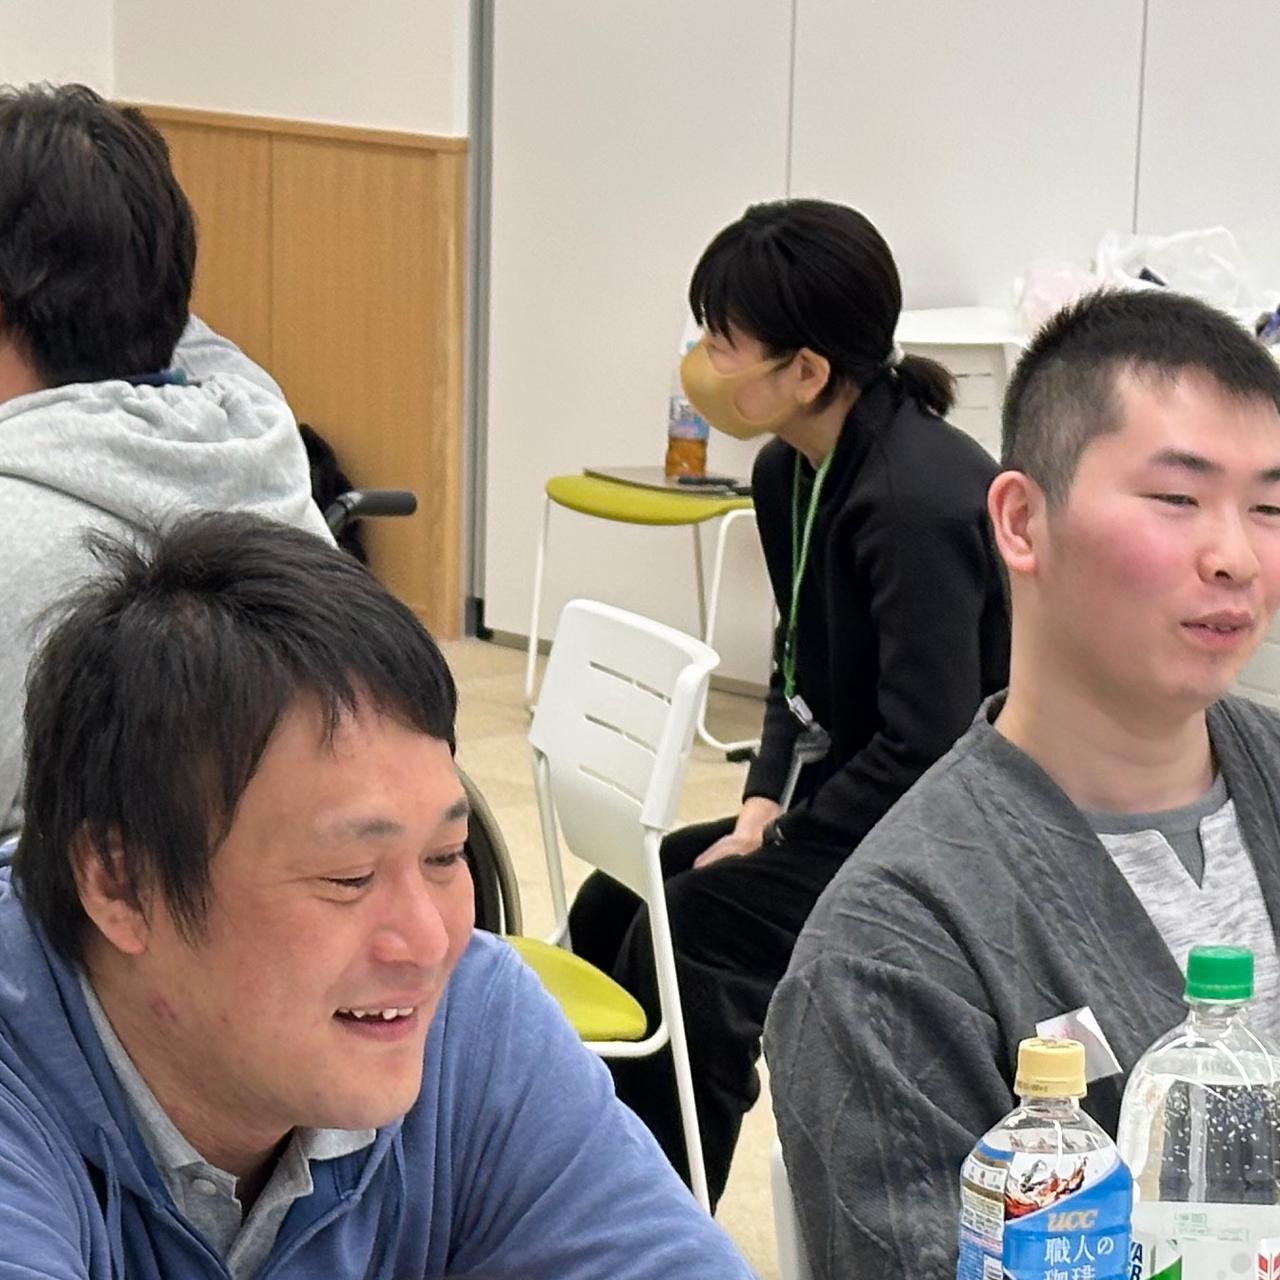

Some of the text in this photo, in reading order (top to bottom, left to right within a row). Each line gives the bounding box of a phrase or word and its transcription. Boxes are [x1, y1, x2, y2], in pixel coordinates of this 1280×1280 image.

[1047, 1210, 1099, 1232] UCC
[1043, 1234, 1115, 1266] 職人の
